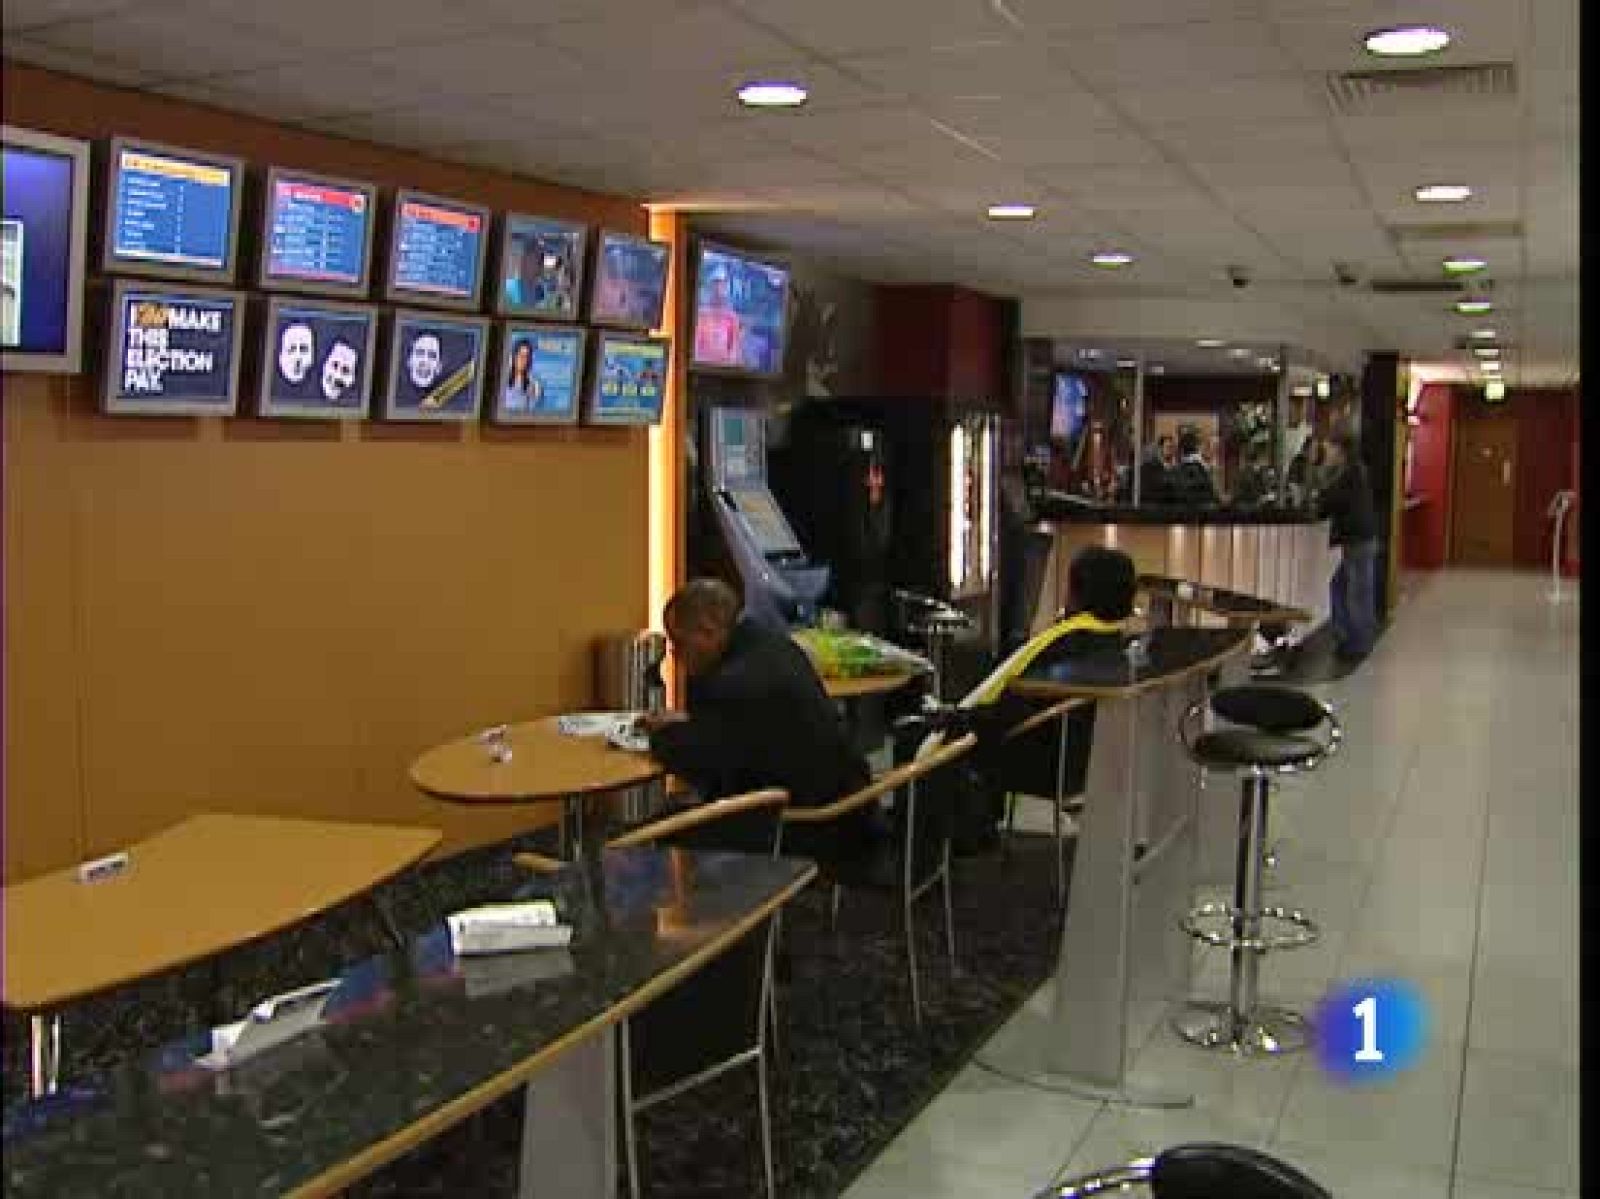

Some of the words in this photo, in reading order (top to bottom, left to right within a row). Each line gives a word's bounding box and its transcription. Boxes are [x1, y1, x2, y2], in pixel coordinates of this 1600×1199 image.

[168, 307, 222, 332] MAKE
[128, 328, 167, 348] THIS
[127, 348, 213, 371] ELECTION
